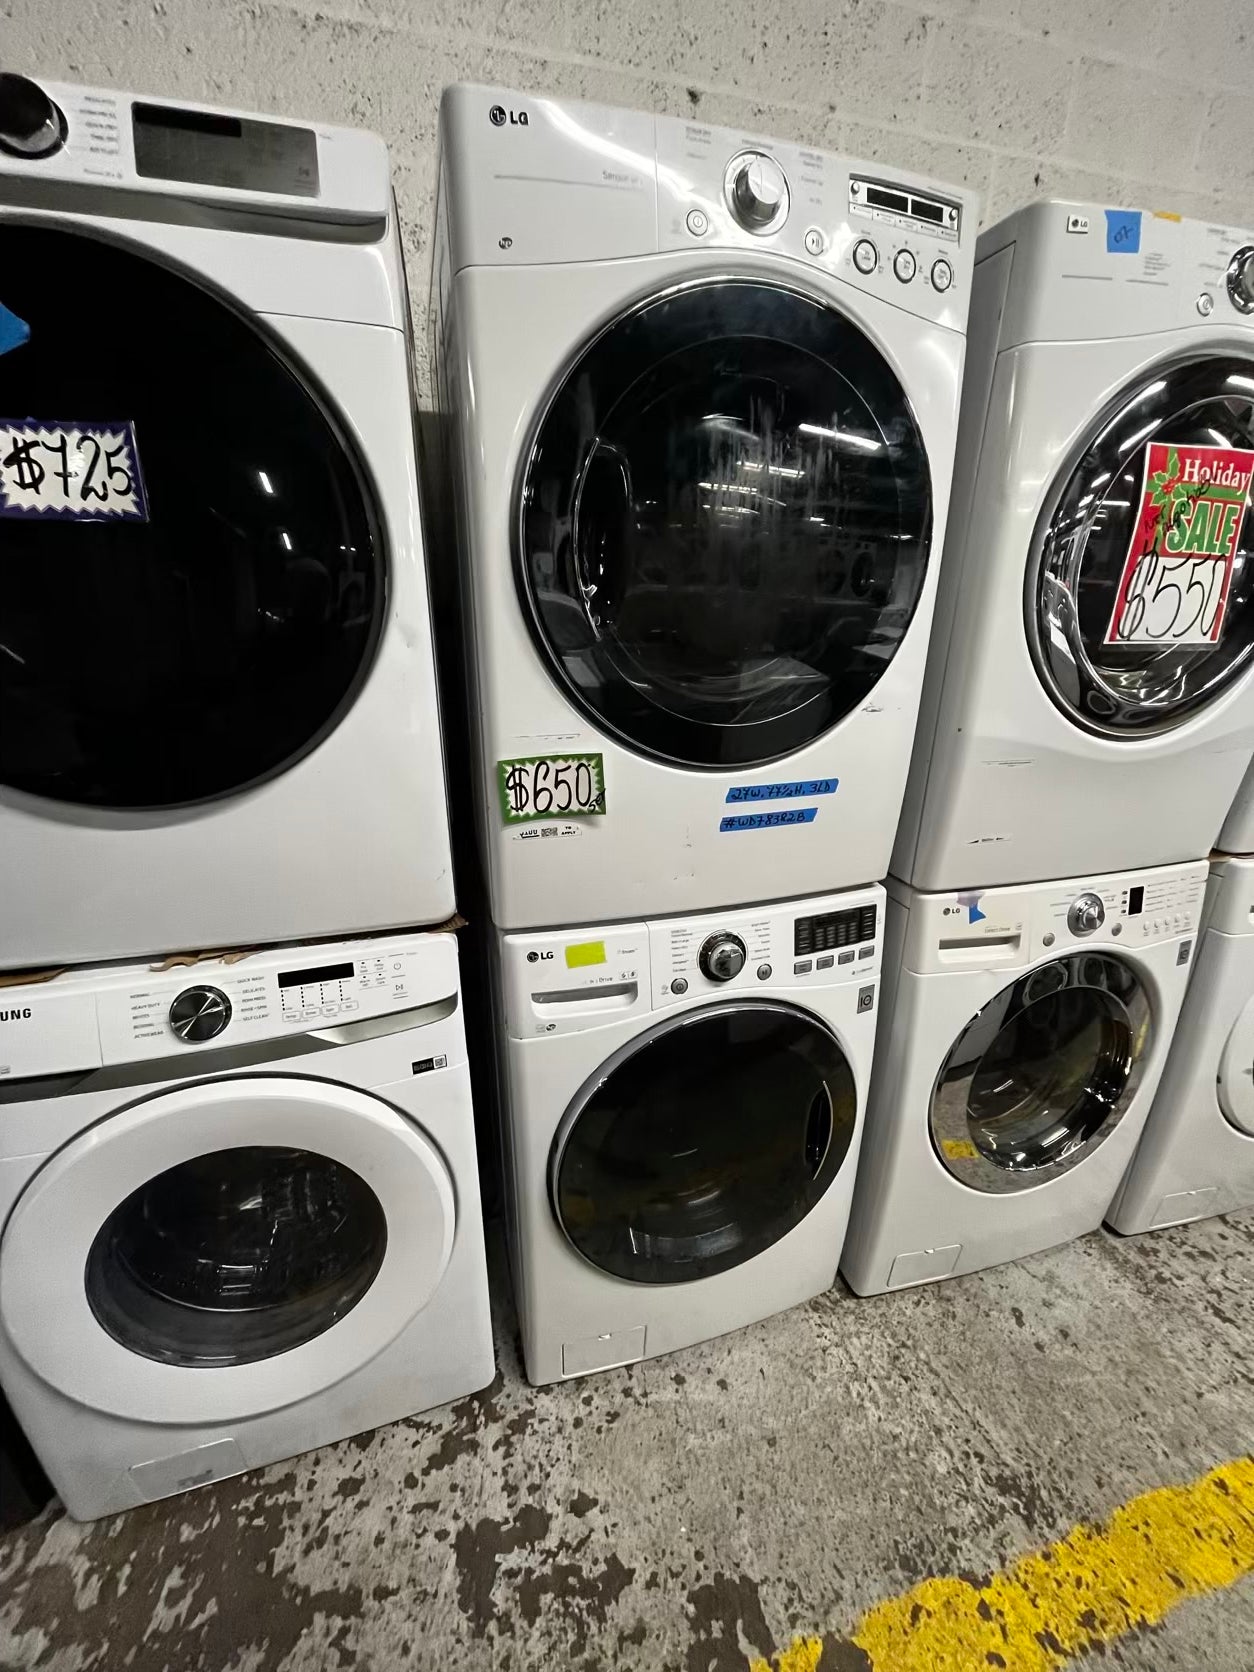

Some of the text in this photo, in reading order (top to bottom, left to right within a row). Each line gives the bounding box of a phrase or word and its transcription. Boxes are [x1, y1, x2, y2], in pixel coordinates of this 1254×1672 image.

[510, 110, 529, 126] LG
[2, 433, 132, 502] $725
[1182, 459, 1250, 496] Holiday
[1165, 498, 1241, 557] SALE
[1118, 538, 1227, 641] $550
[540, 951, 554, 960] LG
